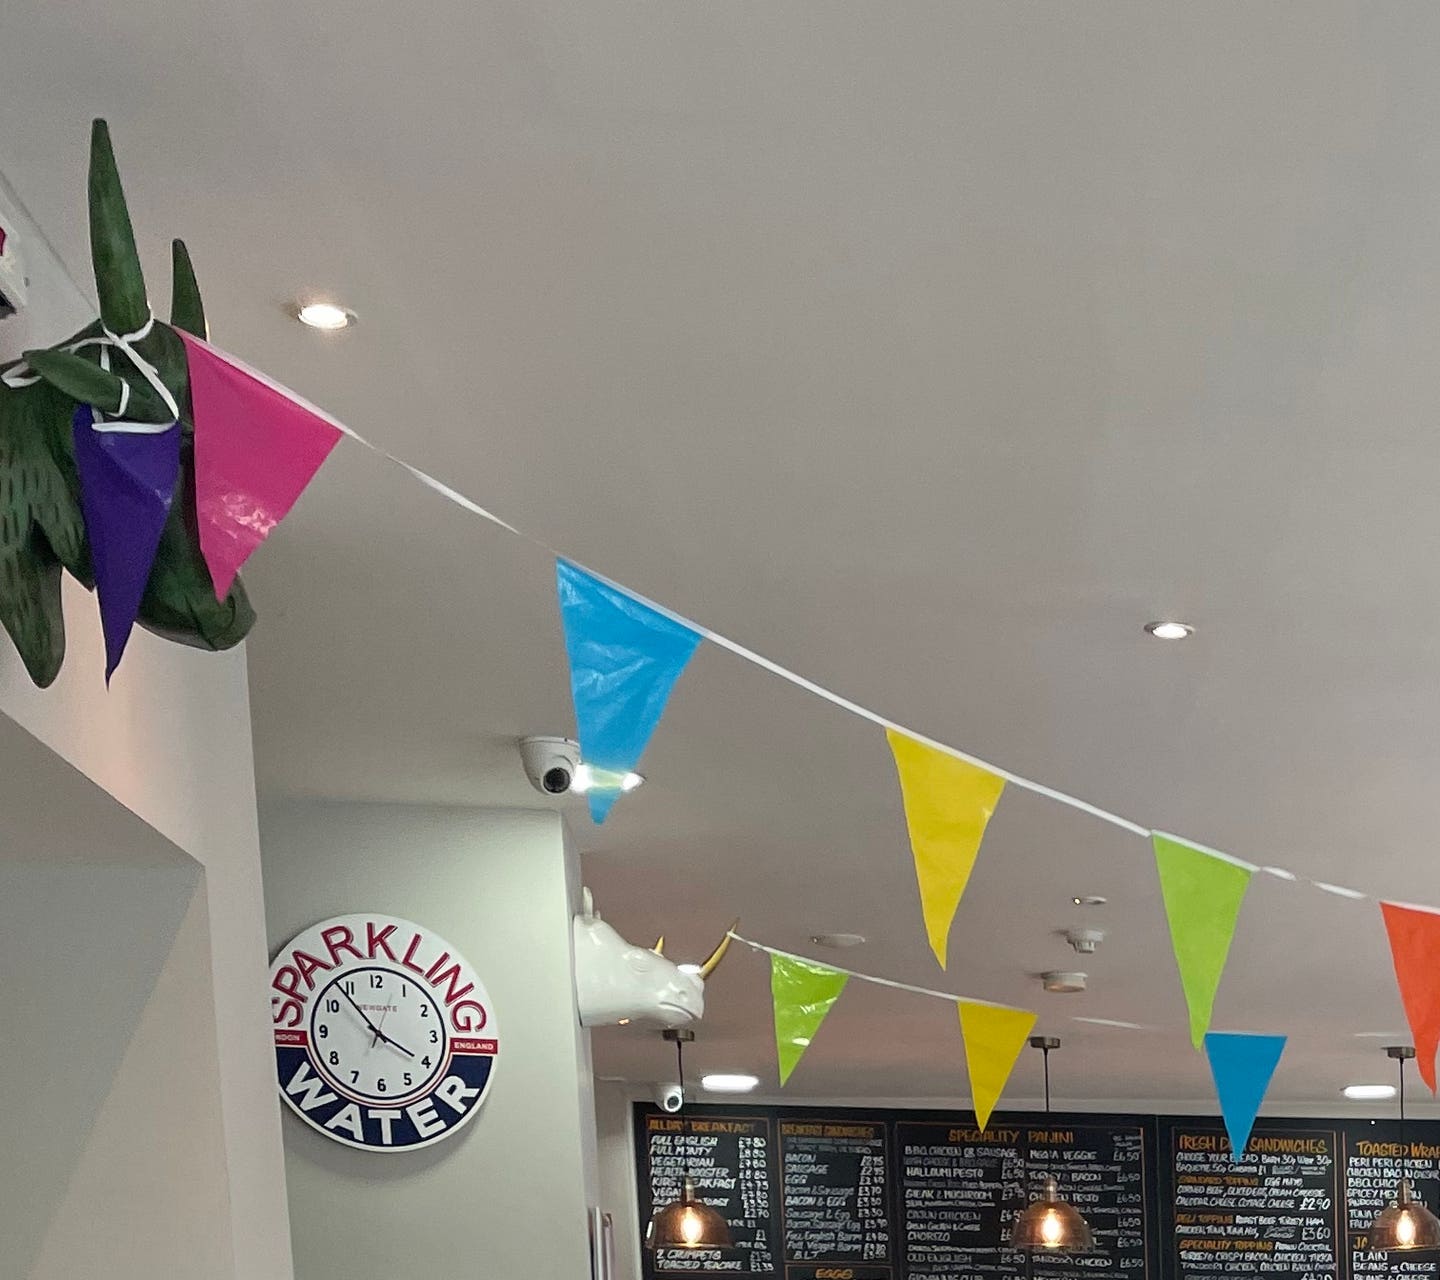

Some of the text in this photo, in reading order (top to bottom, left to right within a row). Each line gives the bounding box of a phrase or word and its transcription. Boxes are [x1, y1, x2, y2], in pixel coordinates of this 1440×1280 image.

[272, 922, 487, 1033] SPARKLING
[370, 975, 382, 989] 12
[402, 984, 406, 997] 1
[326, 1000, 339, 1013] 10
[420, 1005, 428, 1017] 2
[319, 1025, 329, 1038] 9
[429, 1030, 438, 1043] 3
[454, 1042, 494, 1050] ENGLAND
[329, 1051, 339, 1065] 8
[421, 1056, 431, 1069] 4
[350, 1071, 359, 1083] 7
[404, 1073, 412, 1086] 5
[377, 1079, 386, 1091] 6
[285, 1061, 480, 1144] WATER
[651, 1136, 672, 1145] FULL
[1179, 1136, 1215, 1151] FRESH
[1250, 1137, 1328, 1153] SANDWICHES
[650, 1146, 673, 1155] FULL
[1356, 1141, 1408, 1157] TOASTED
[1349, 1157, 1393, 1167] PERI PERI
[1348, 1178, 1371, 1188] BBQ
[1353, 1251, 1388, 1261] PLAIN
[1353, 1262, 1436, 1272] BEANS CHEESE
